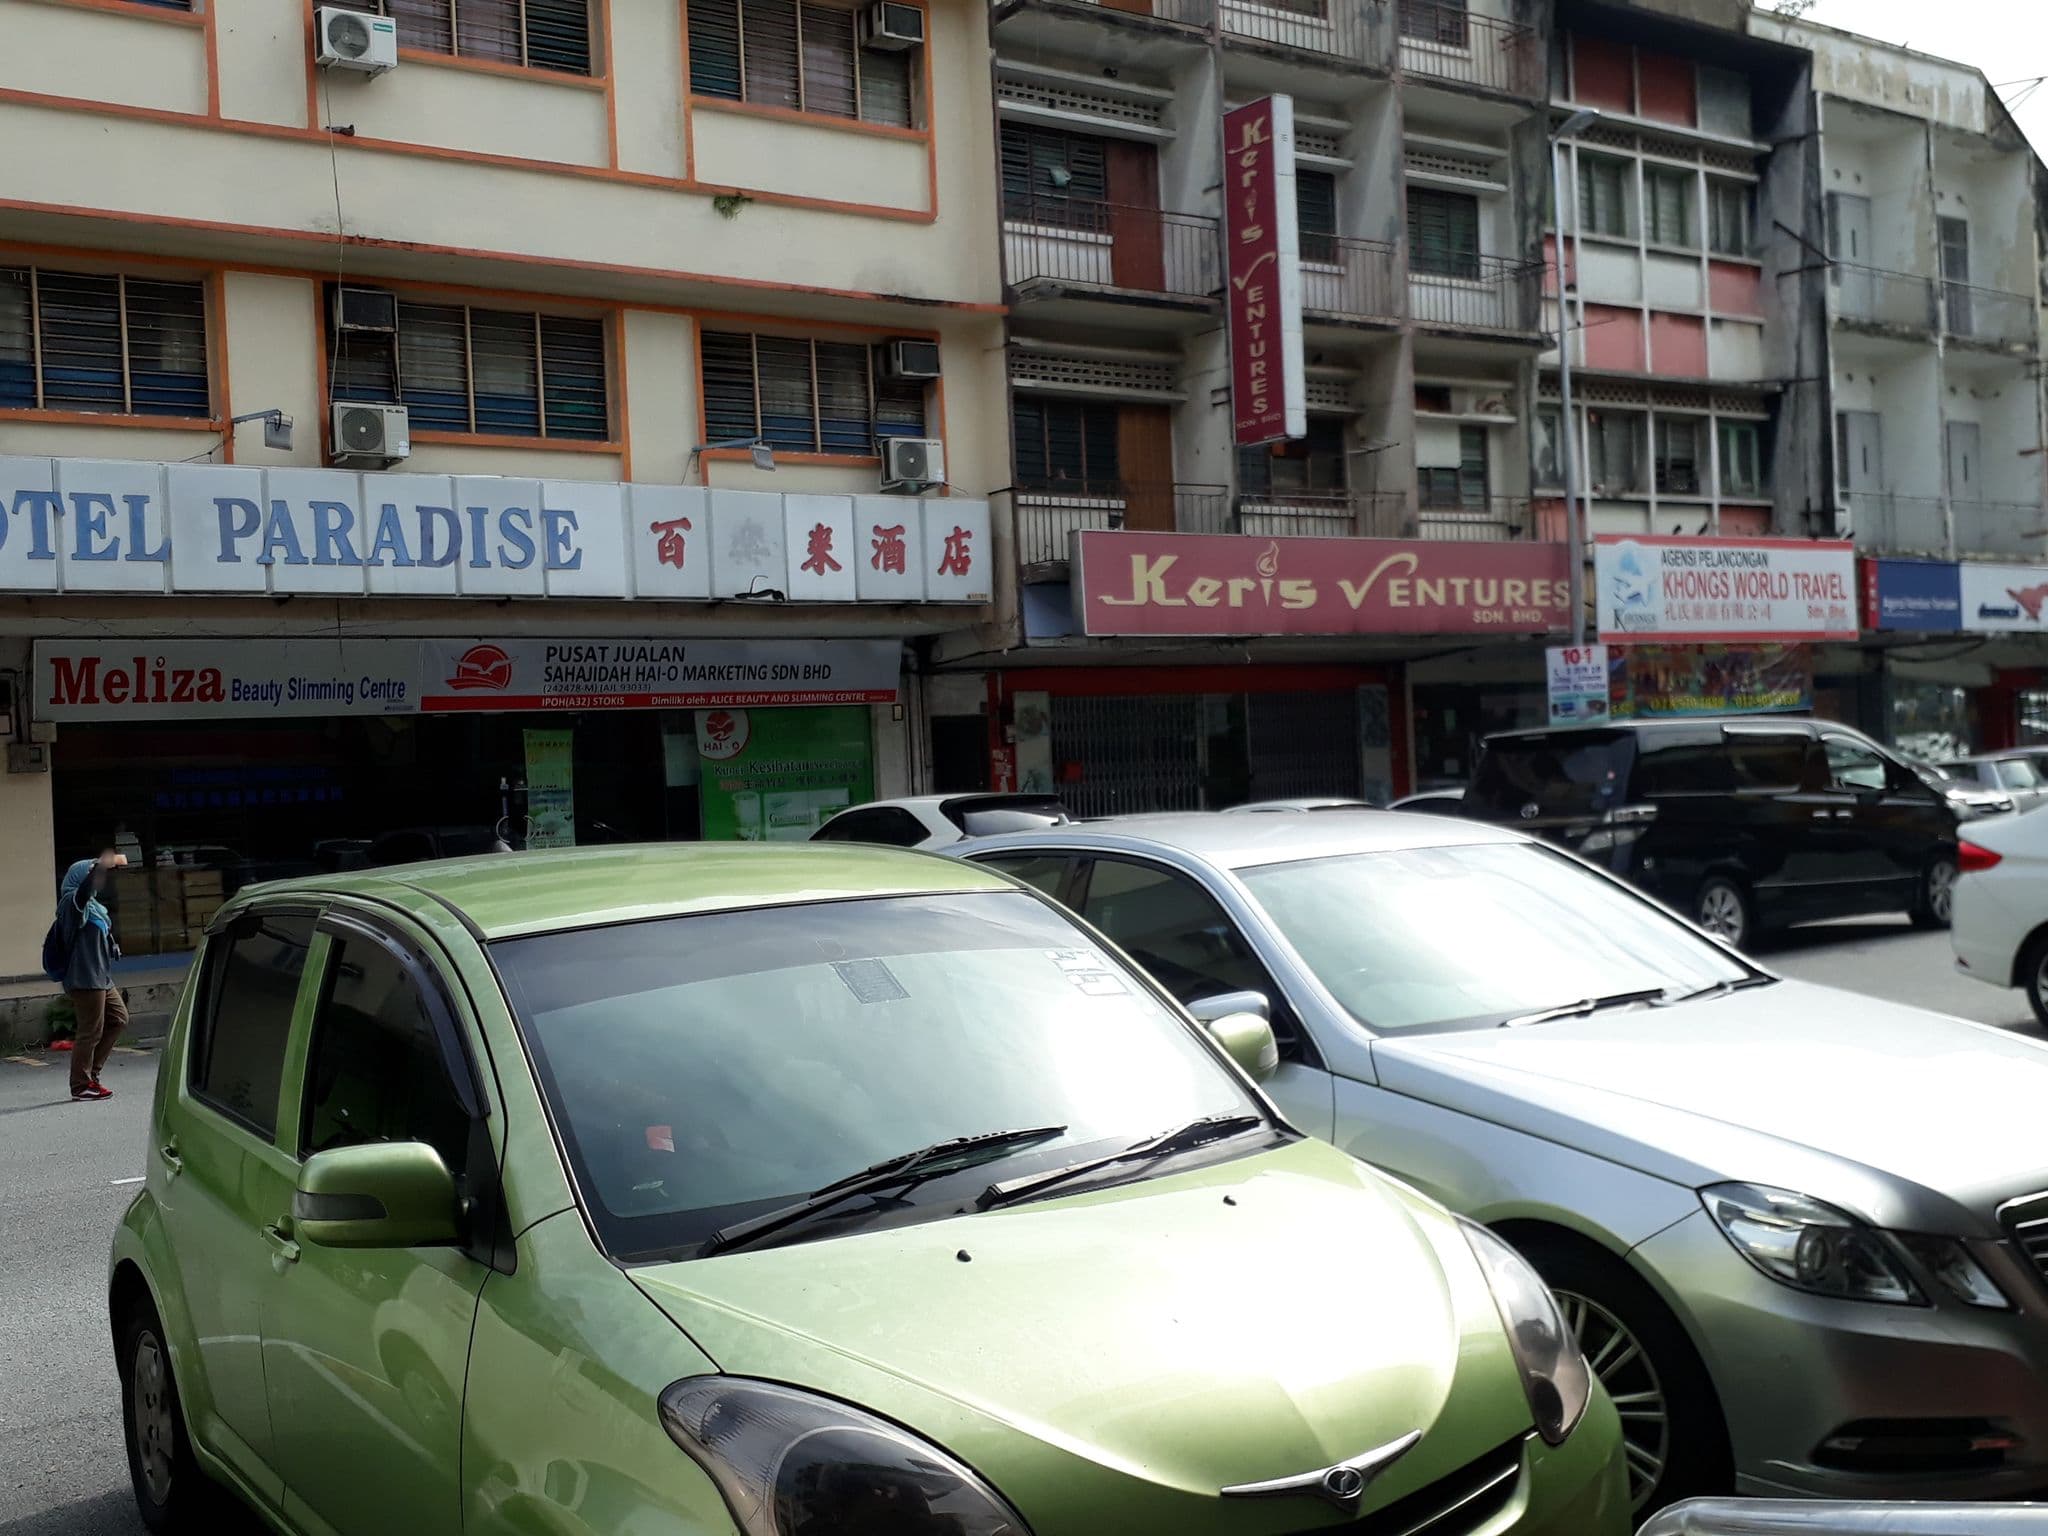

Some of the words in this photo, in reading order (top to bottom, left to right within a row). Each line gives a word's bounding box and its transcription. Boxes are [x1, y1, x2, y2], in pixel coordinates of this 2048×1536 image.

[0, 490, 172, 562] TEL
[213, 498, 582, 571] PARADISE
[1099, 541, 1318, 609] Keris
[1337, 552, 1570, 610] VENTURES
[1663, 570, 1730, 600] KHONGS
[1733, 571, 1789, 600] WORLD
[1792, 573, 1847, 600] TRAVEL
[546, 646, 609, 663] PUSAT
[613, 645, 685, 662] JUALAN
[49, 656, 226, 705] Meliza
[543, 665, 631, 683] SAHAJIDAH
[635, 665, 679, 682] HAI-O
[682, 664, 767, 682] MARKETING
[770, 664, 799, 681] SDN
[803, 664, 831, 680] BHD
[231, 678, 283, 708] Beauty
[287, 676, 354, 706] Slimming
[360, 676, 406, 699] Centre
[710, 694, 734, 705] ALICE
[736, 694, 770, 704] BEAUTY
[771, 693, 790, 703] AND
[791, 693, 834, 703] SLIMMING
[835, 692, 866, 702] CENTRE
